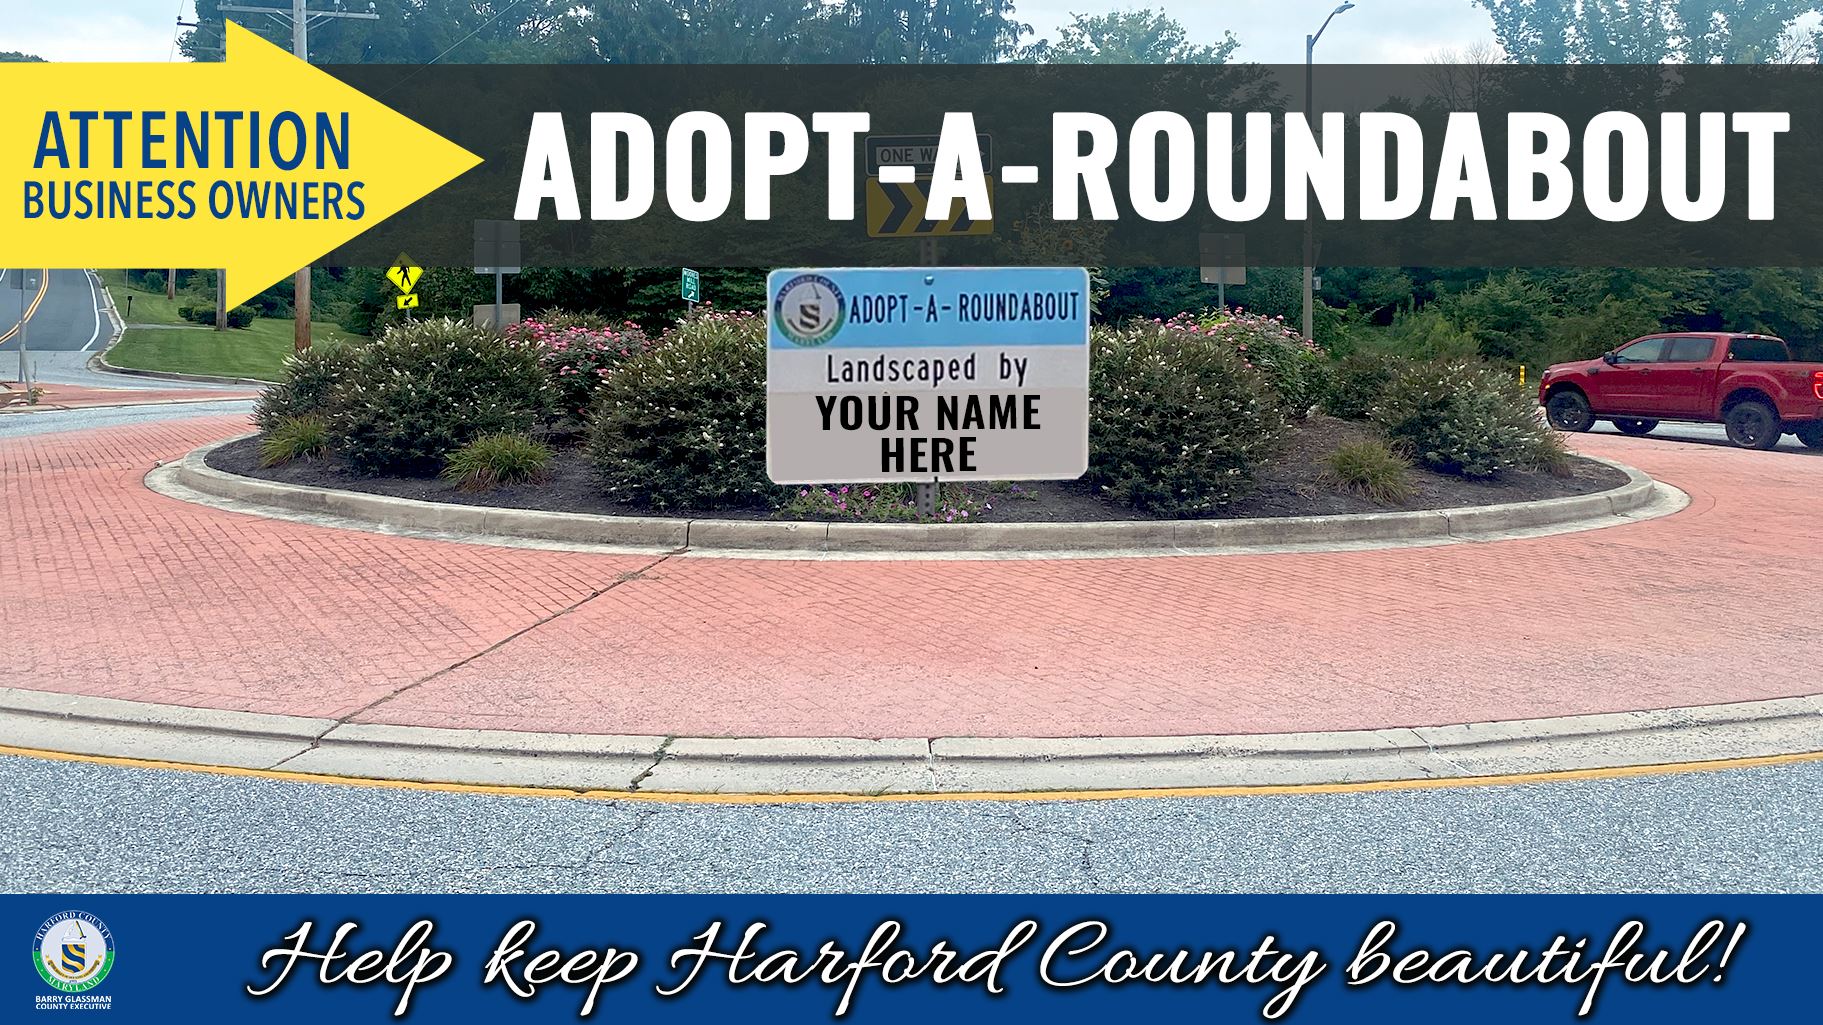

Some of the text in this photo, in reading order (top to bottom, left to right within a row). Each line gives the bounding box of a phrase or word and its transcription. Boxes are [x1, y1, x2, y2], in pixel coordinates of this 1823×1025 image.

[880, 148, 914, 163] ONE
[827, 351, 1028, 388] Landscaped by
[815, 394, 1042, 431] YOUR NAME
[880, 436, 978, 473] HERE
